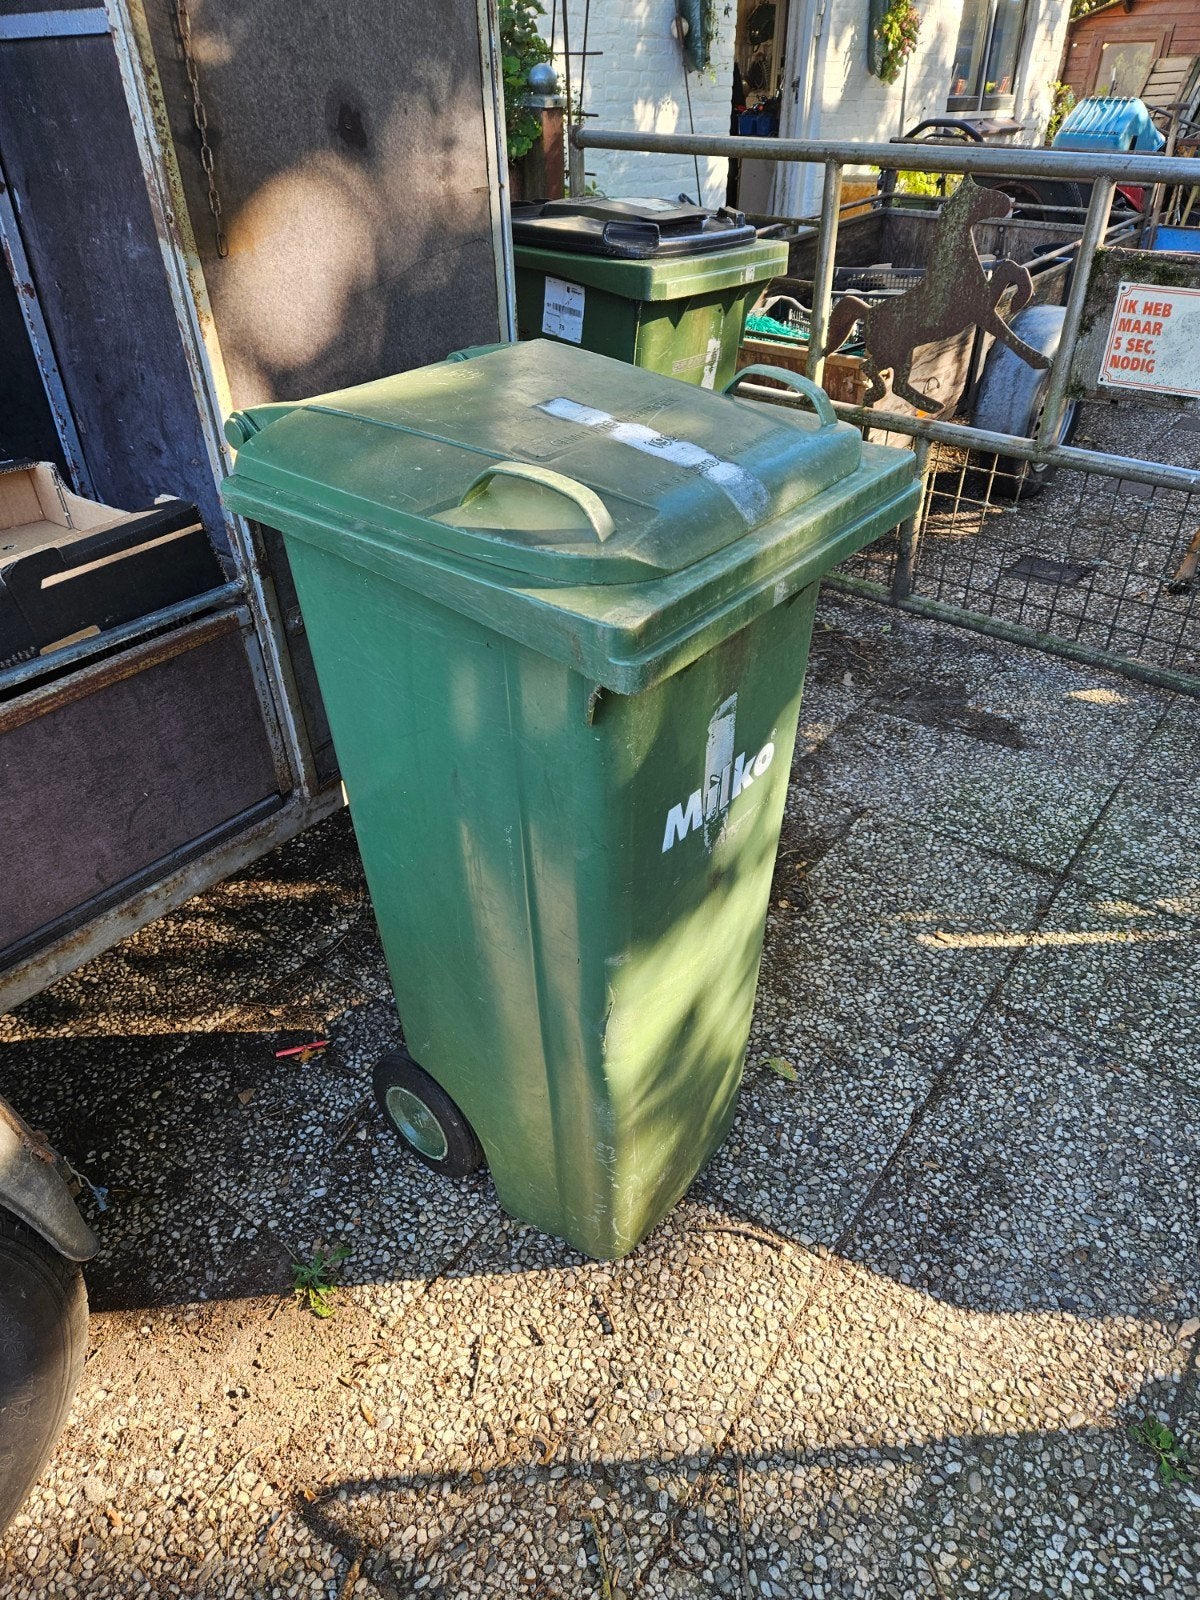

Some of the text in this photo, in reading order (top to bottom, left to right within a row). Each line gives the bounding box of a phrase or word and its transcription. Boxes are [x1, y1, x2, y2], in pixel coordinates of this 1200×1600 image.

[1122, 299, 1173, 318] IK HEB
[1117, 318, 1163, 336] MAAR
[1113, 336, 1122, 351] 5
[1109, 355, 1156, 374] NODIG
[661, 742, 775, 854] Milko
